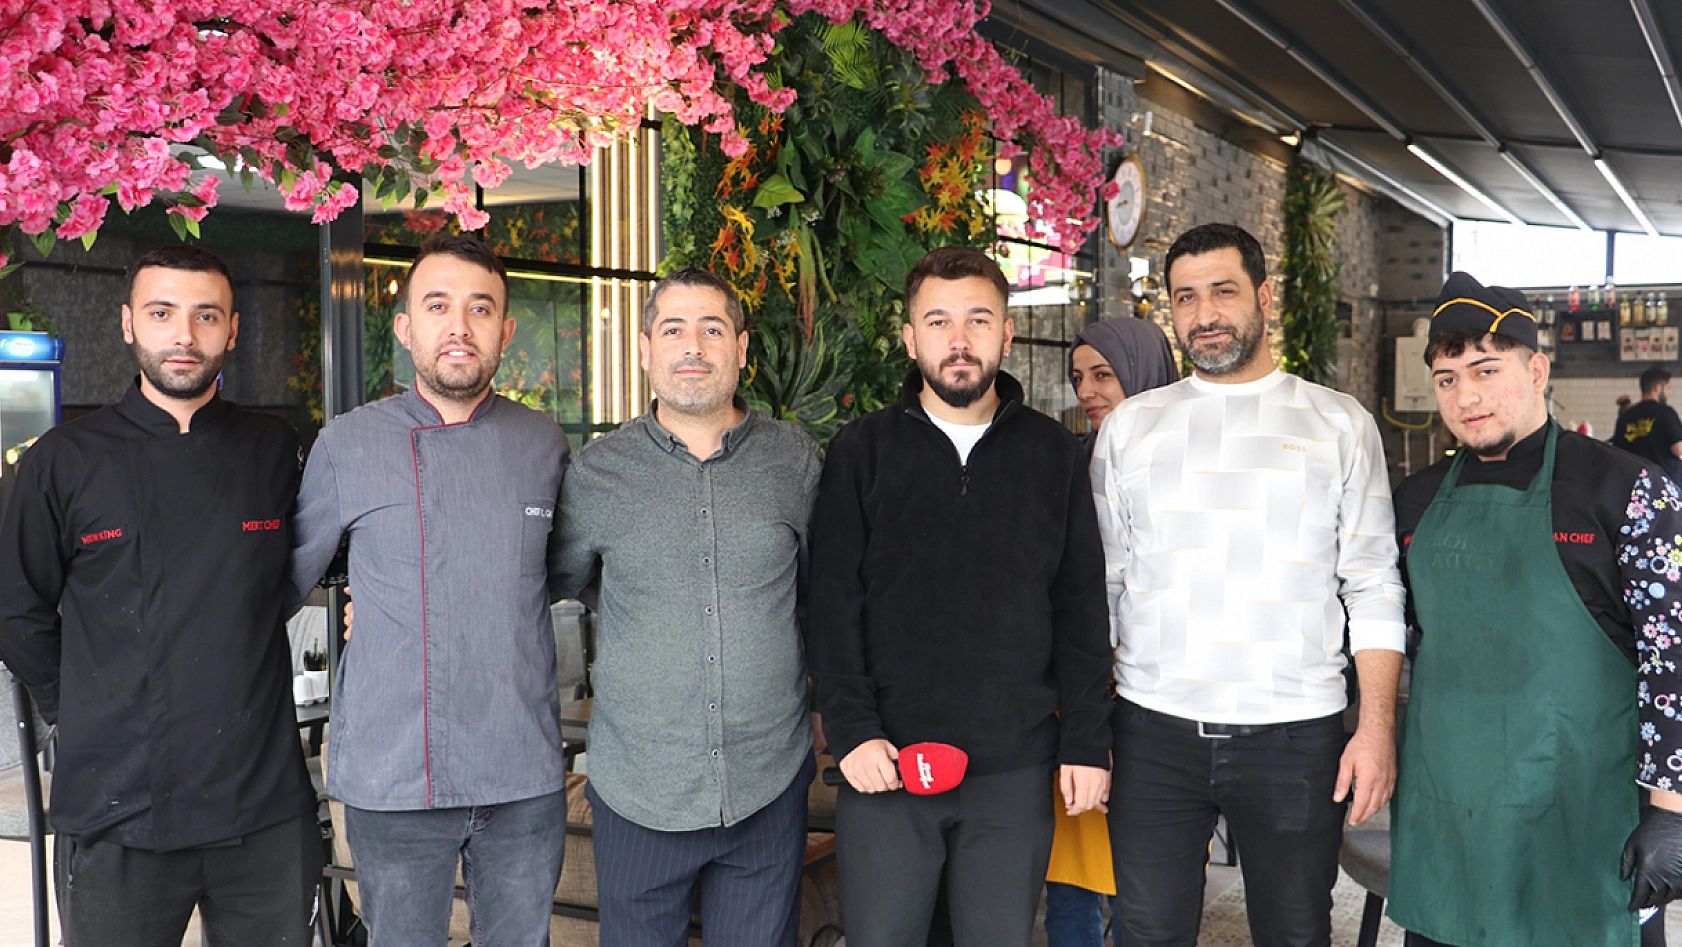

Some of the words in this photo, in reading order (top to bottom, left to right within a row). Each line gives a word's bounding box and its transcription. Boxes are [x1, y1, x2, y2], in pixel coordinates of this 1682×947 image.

[1283, 443, 1307, 453] BOSS
[1553, 532, 1568, 542] AN
[1569, 533, 1595, 544] CHEF
